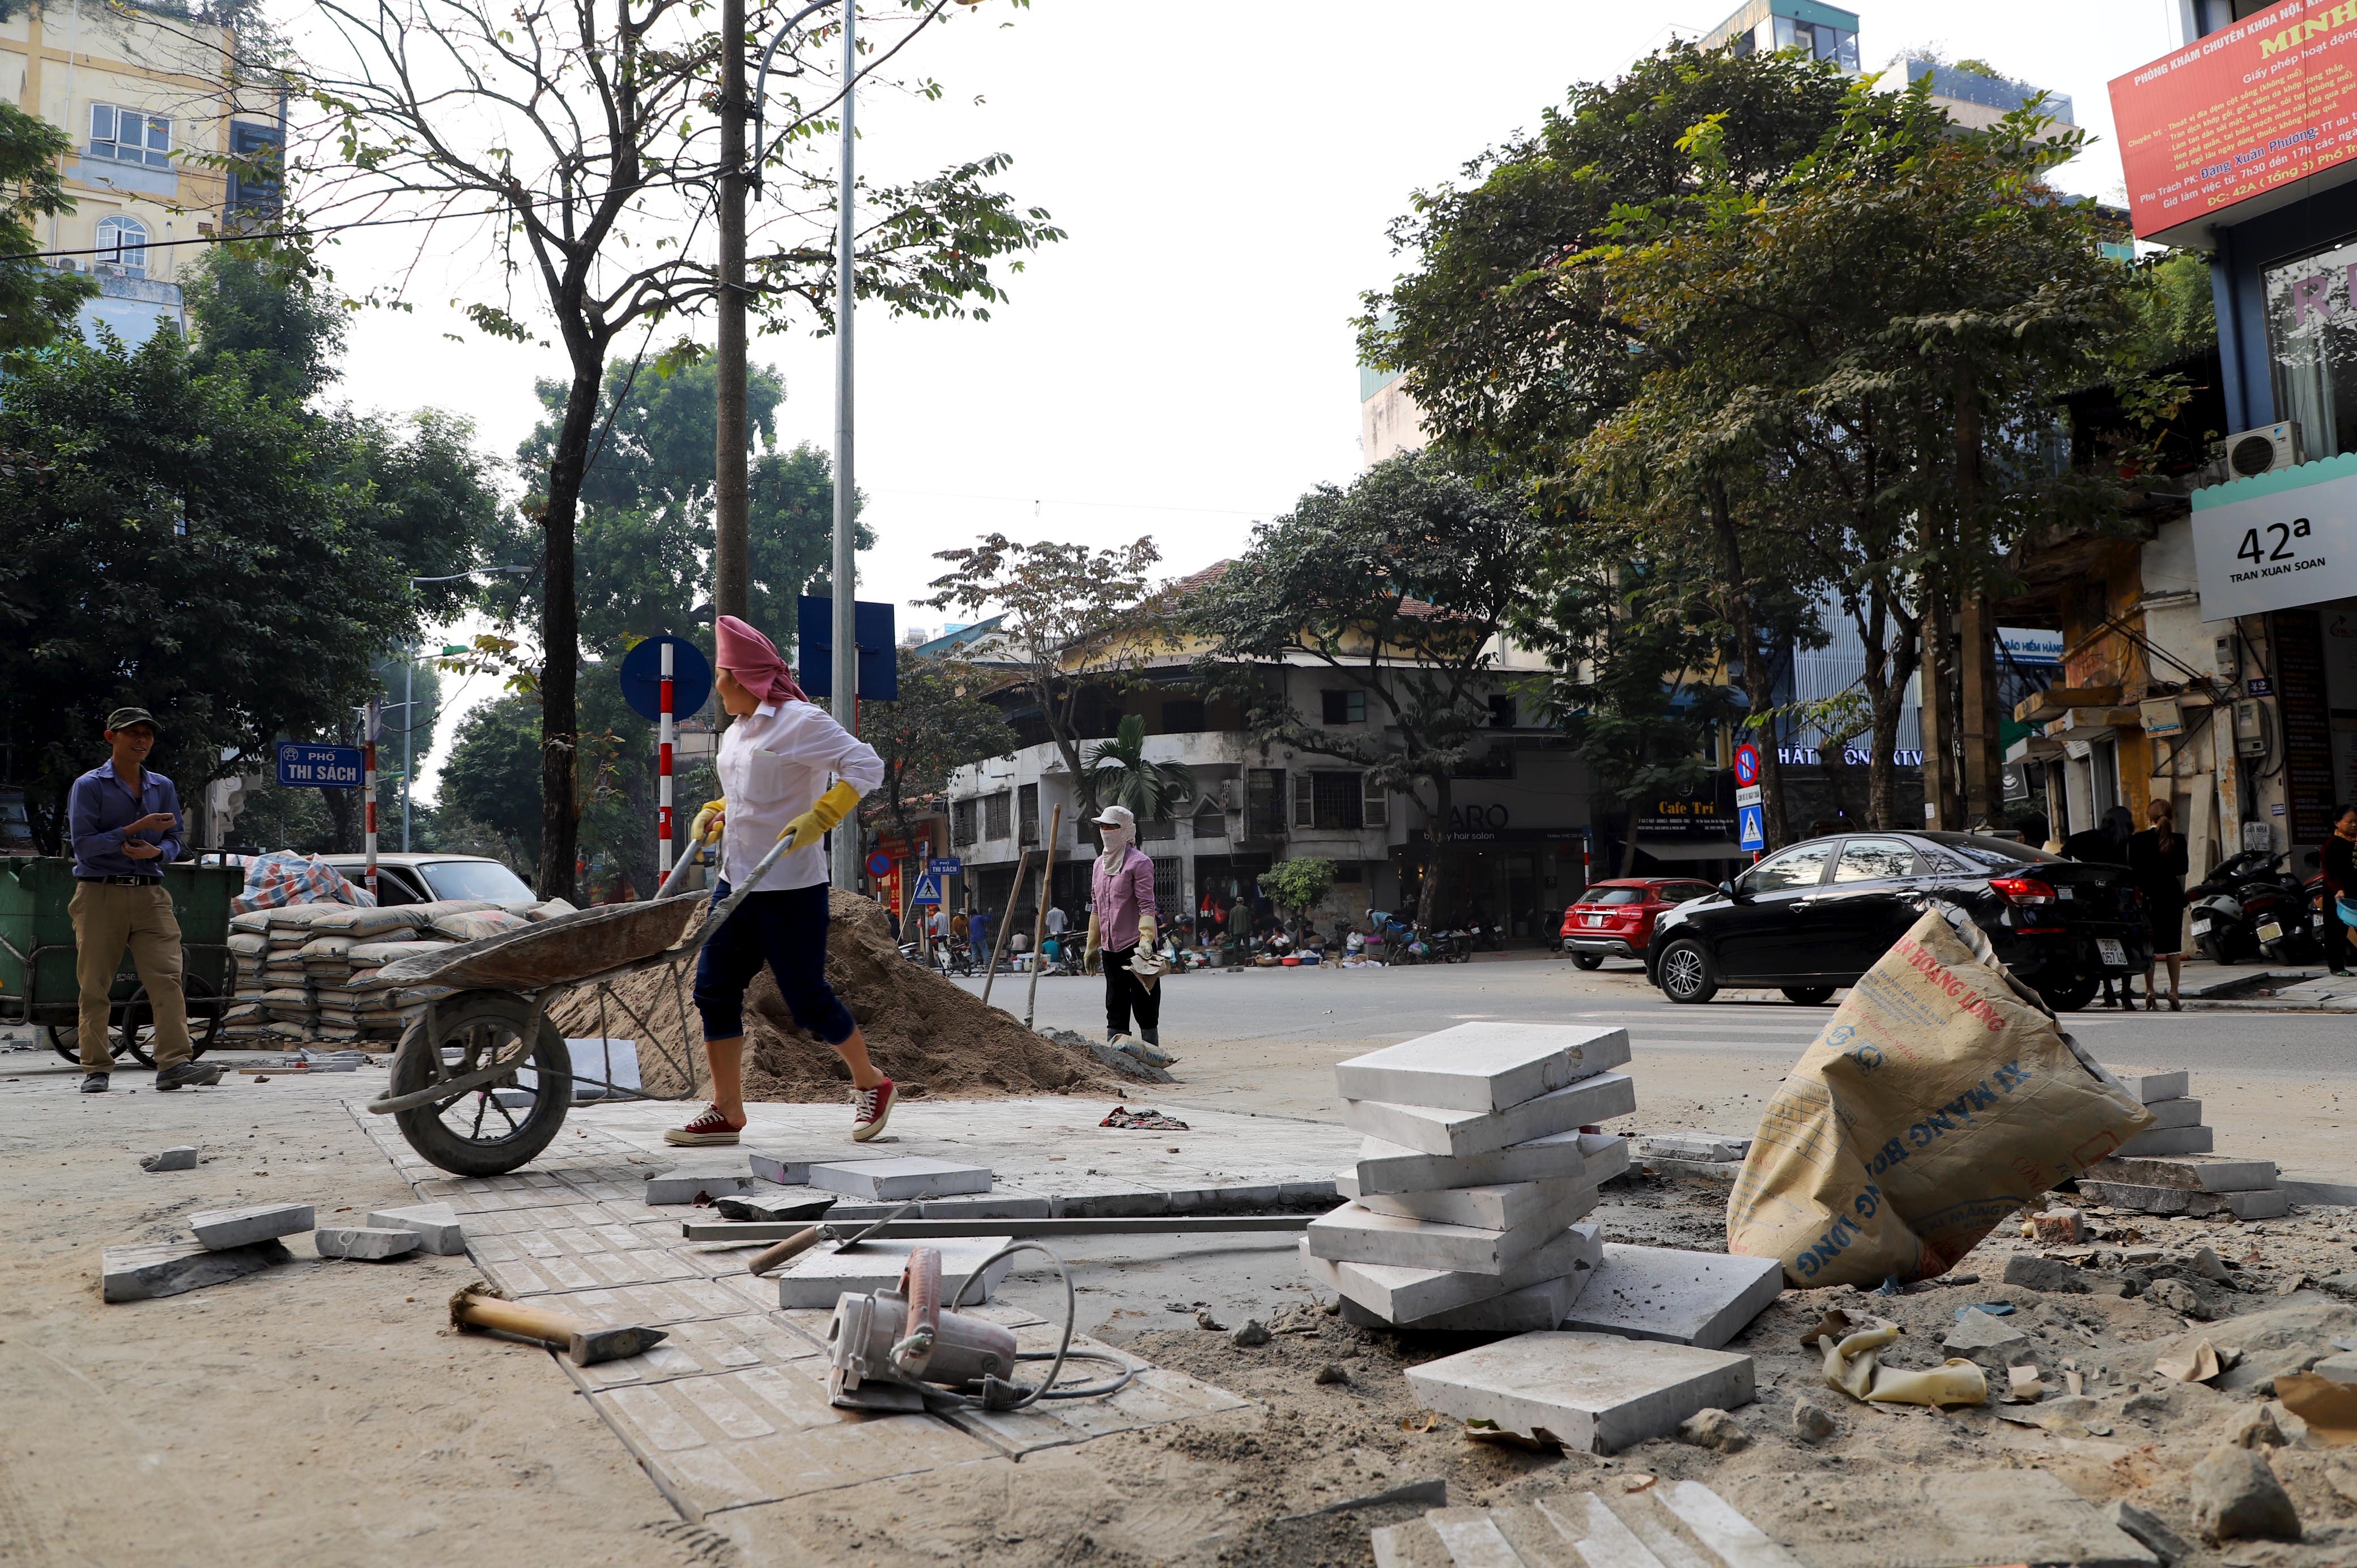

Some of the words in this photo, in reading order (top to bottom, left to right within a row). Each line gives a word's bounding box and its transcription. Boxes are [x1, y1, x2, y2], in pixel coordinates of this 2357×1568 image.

[2134, 63, 2168, 86] PHÒNG
[2169, 48, 2201, 70] KHÁM
[2202, 27, 2245, 55] CHUYÊN
[2247, 13, 2277, 35] KHOA
[2279, 2, 2304, 20] NỘI,
[2259, 0, 2357, 59] MINH
[2243, 67, 2267, 84] Giấy
[2270, 55, 2298, 74] phép
[2301, 41, 2328, 59] hoạt
[2128, 134, 2151, 148] Chuyên
[2168, 117, 2188, 131] Thoát
[2140, 192, 2156, 204] Phụ
[2158, 181, 2181, 196] Trách
[2200, 160, 2231, 180] Đặng
[2233, 146, 2266, 167] Xuân
[2163, 196, 2178, 208] Giờ
[2181, 189, 2198, 202] làm
[2201, 180, 2221, 194] việc
[2239, 161, 2266, 180] 7h30
[2269, 155, 2288, 168] đến
[2291, 145, 2312, 160] 17h
[2315, 137, 2335, 151] các
[2207, 193, 2230, 206] ĐC:
[2232, 182, 2257, 197] 42A
[2317, 147, 2344, 165] Phố
[2230, 570, 2258, 583] TRAN
[2261, 564, 2292, 578] XUAN
[2294, 557, 2326, 571] SOAN
[2250, 680, 2266, 691] 42
[288, 764, 312, 779] THI
[317, 763, 356, 781] SÁCH
[308, 750, 336, 761] PHỐ
[1658, 801, 1687, 815] Cafe
[1692, 801, 1714, 815] Trí
[1958, 991, 2006, 1032] LONG
[1993, 1059, 2032, 1093] XI
[1909, 1080, 1998, 1147] MĂNG
[1796, 1214, 1862, 1279] LONG
